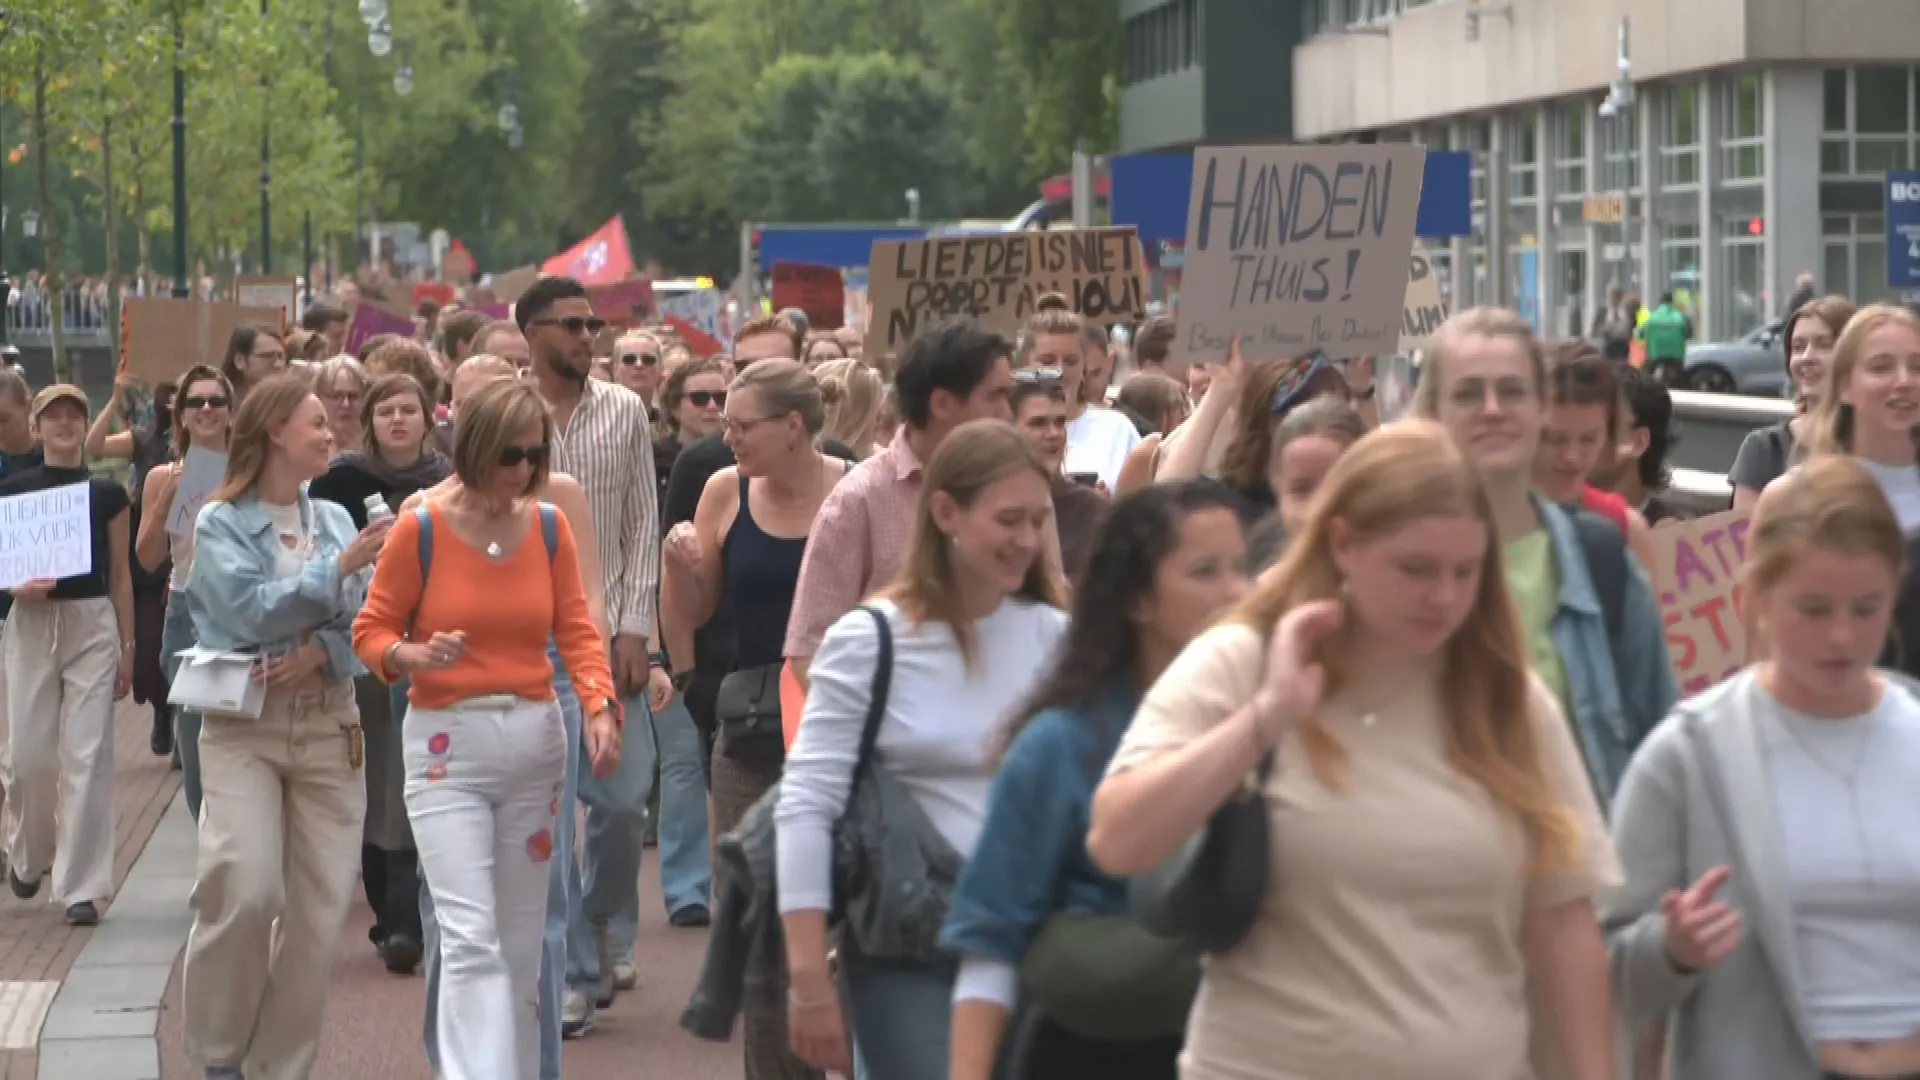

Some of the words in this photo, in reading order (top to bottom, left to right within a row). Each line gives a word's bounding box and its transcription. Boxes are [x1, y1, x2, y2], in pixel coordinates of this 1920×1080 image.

[1197, 155, 1392, 250] HANDEN
[1038, 233, 1066, 272] IS
[28, 515, 82, 546] VOOR
